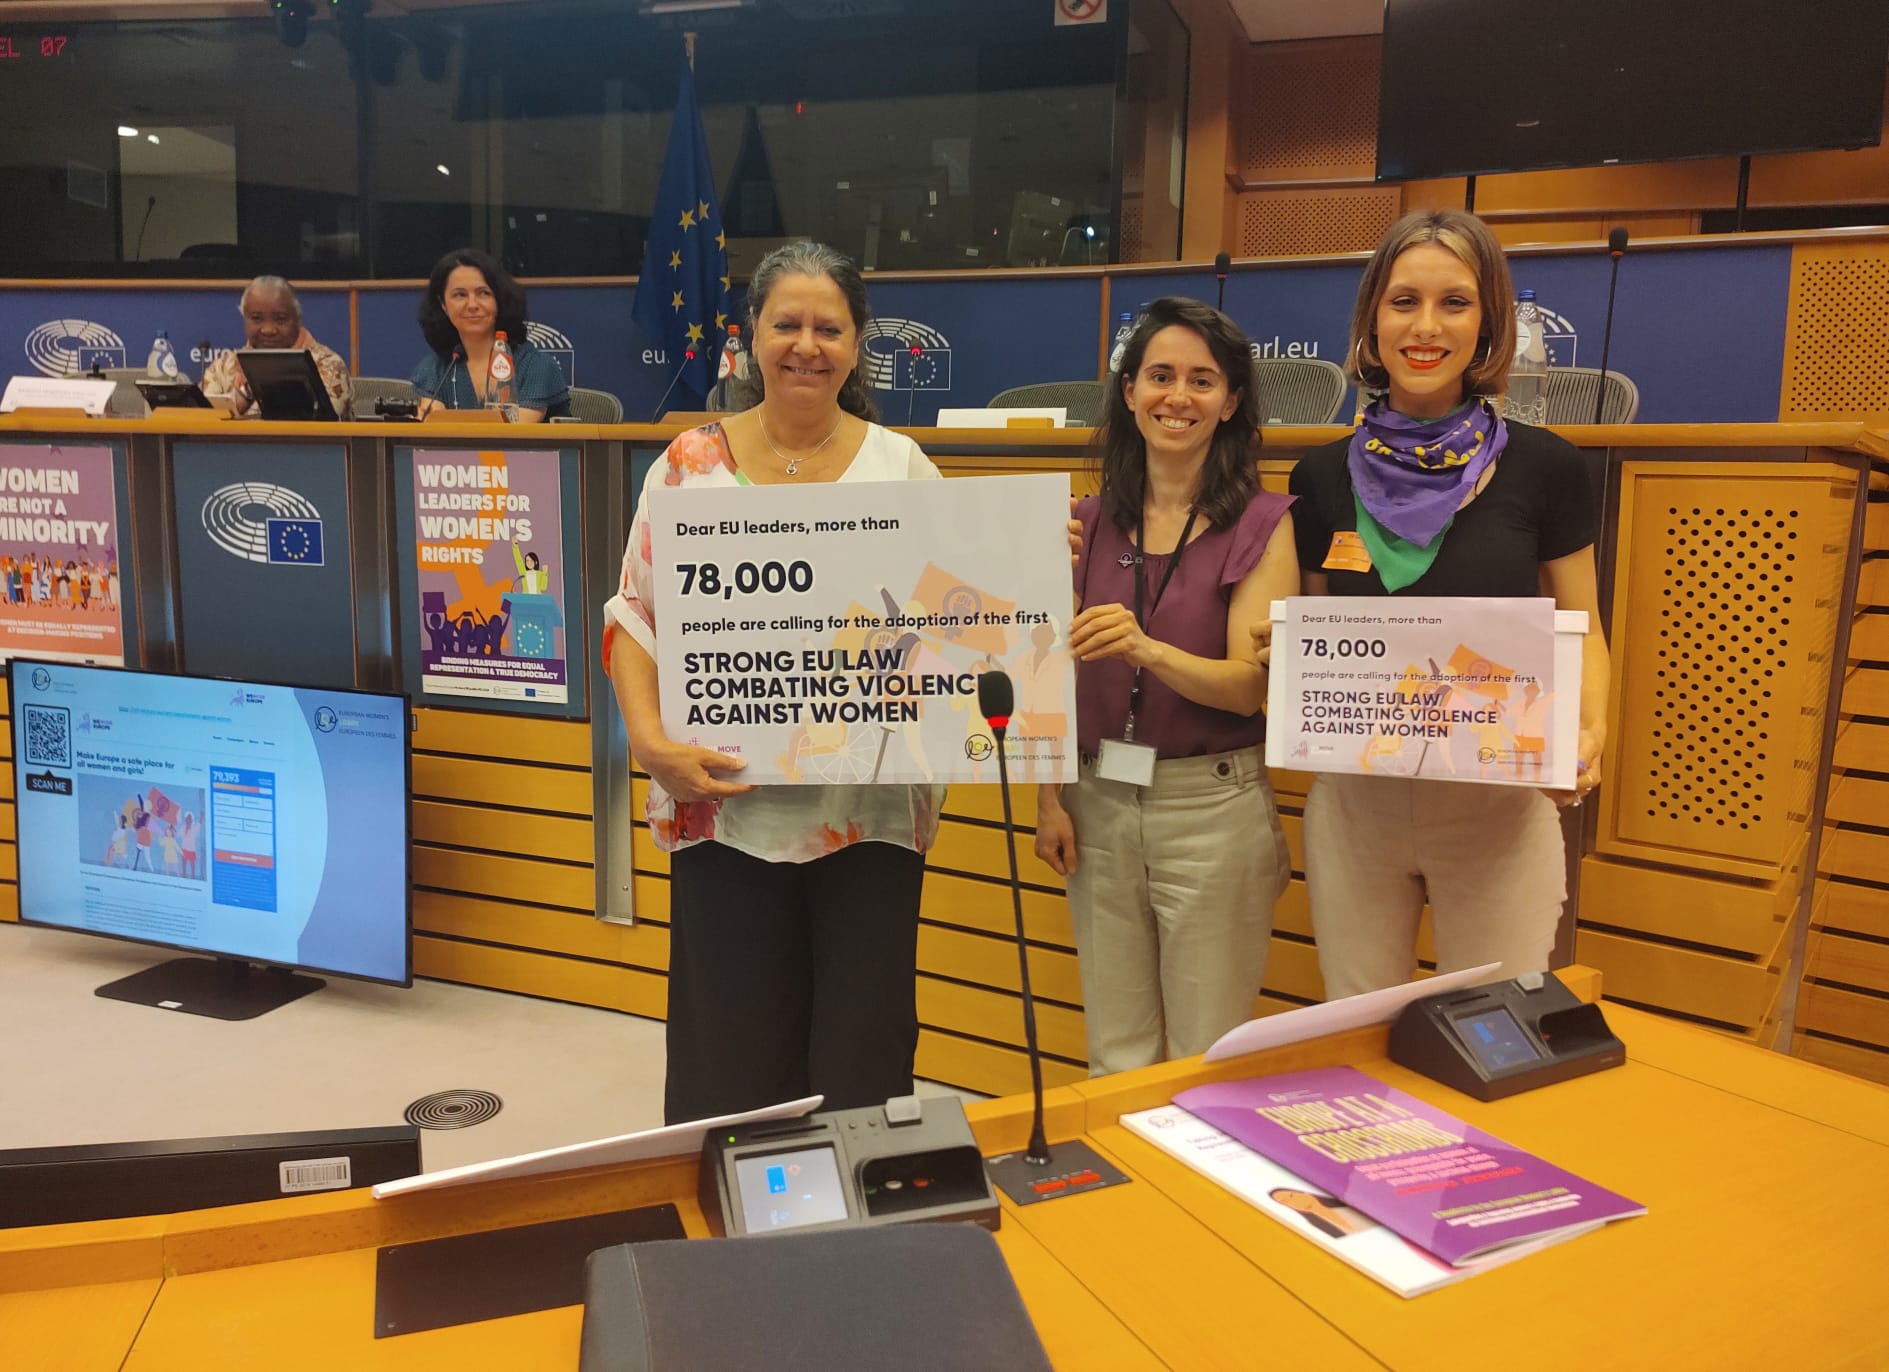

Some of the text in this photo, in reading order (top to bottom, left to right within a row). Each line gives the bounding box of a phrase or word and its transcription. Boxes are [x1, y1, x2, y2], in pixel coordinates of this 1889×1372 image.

[40, 35, 67, 57] 07
[418, 465, 508, 488] WOMEN
[0, 496, 67, 515] RE NOT A
[419, 493, 530, 512] LEADERS FOR
[419, 516, 532, 541] WOMEN'S
[676, 515, 901, 537] Dear EU leaders, more than
[422, 546, 484, 564] RIGHTS
[676, 561, 813, 600] 78,000
[682, 609, 1049, 635] people are calling for the adoption of the first
[1302, 614, 1442, 625] Dear EU leaders, more than
[1301, 638, 1387, 660] 78,000
[441, 656, 546, 671] BINDING MEASURES FOR EQUAL
[684, 648, 904, 674] STRONG EU LAW
[430, 663, 489, 675] REPRESENTATION
[496, 668, 514, 677] TRUE
[514, 669, 558, 680] DEMOCRACY
[1302, 670, 1537, 684] people are calling for the adoption of the first
[685, 675, 850, 700] COMBATING
[1302, 690, 1441, 707] STRONG EU LAW
[687, 701, 919, 726] AGAINST WOMEN
[1302, 706, 1497, 724] COMBATING VIOLENCE
[1301, 721, 1449, 738] AGAINST WOMEN
[77, 751, 95, 760] Make
[96, 753, 120, 764] Europe
[127, 756, 142, 765] safe
[144, 759, 163, 768] place
[165, 761, 175, 769] for
[77, 760, 86, 768] all
[112, 764, 126, 772] and
[32, 778, 68, 792] SCAN ME
[1256, 1100, 1364, 1134] EUROPE
